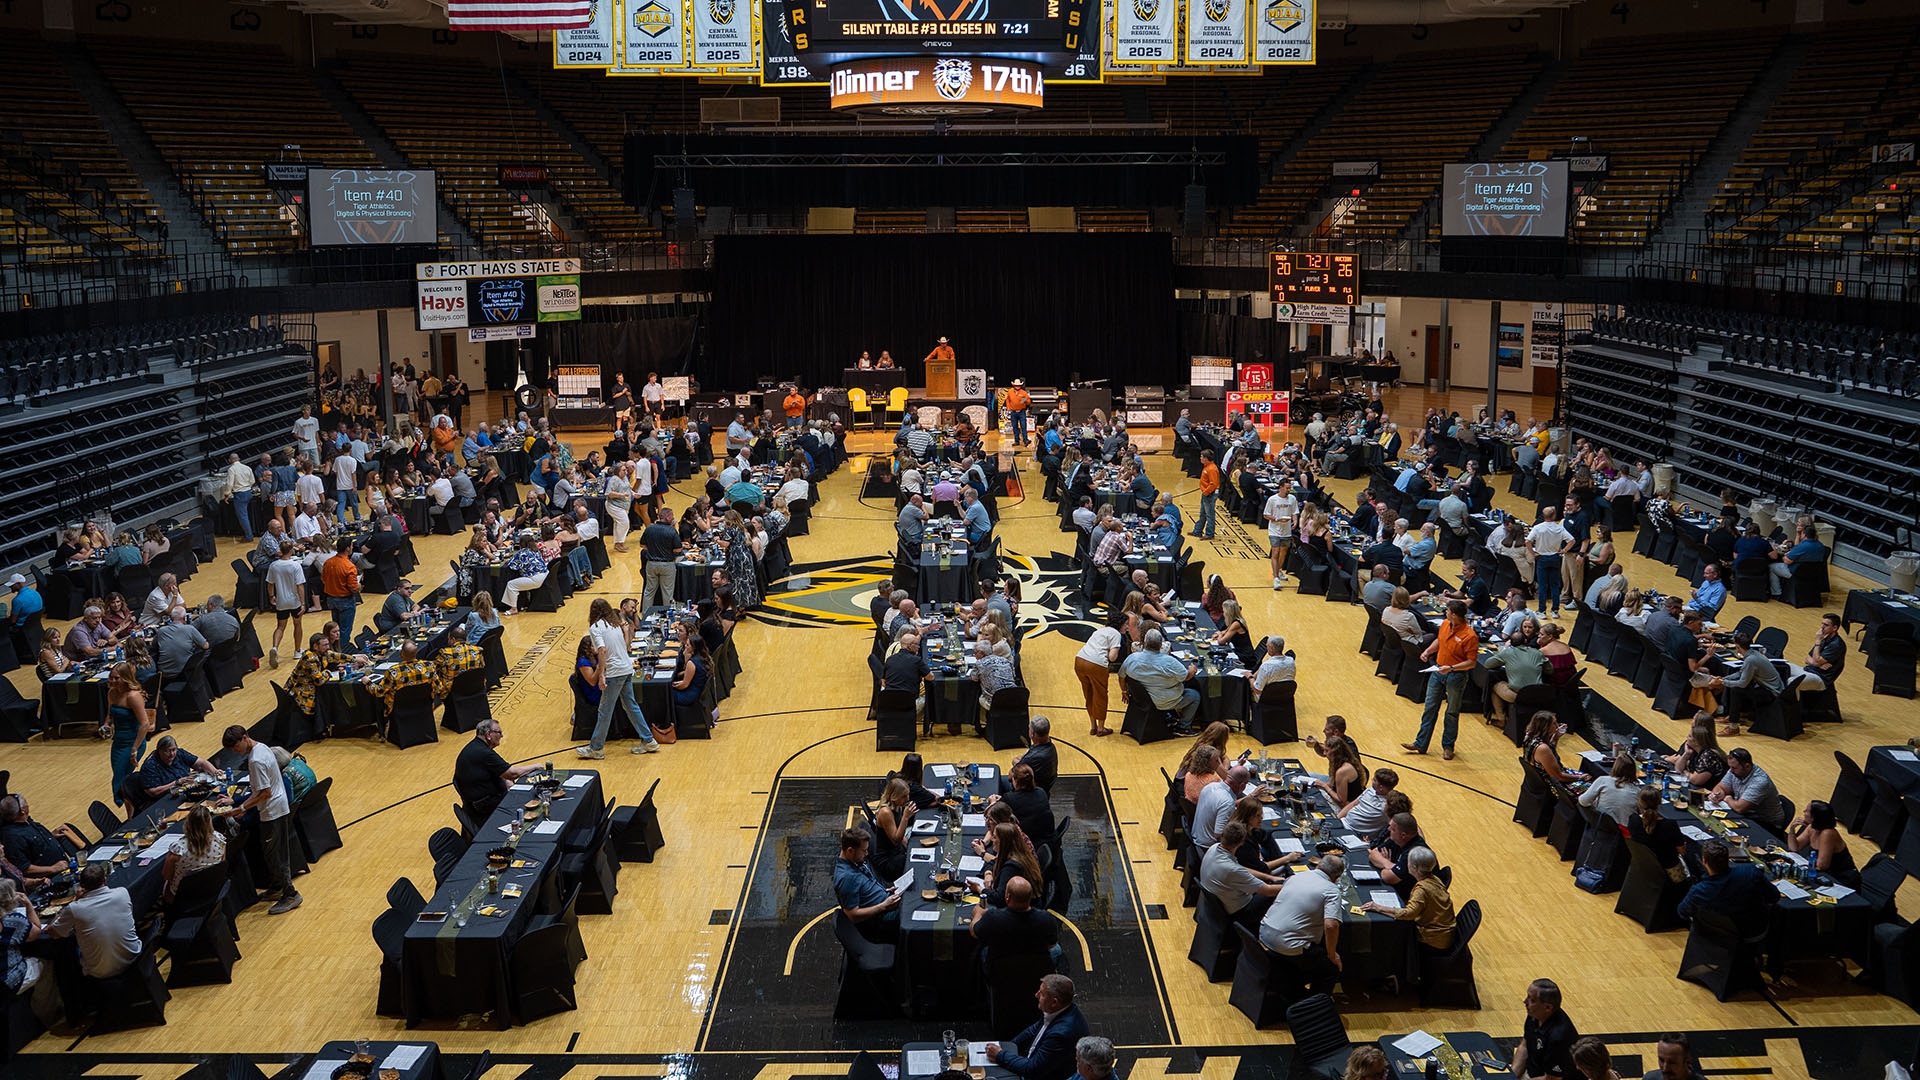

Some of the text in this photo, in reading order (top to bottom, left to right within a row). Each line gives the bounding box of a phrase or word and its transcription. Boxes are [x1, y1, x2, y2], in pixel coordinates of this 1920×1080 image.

[636, 13, 672, 24] MIAA
[1267, 9, 1302, 20] MIAA
[842, 23, 1029, 35] SILENT TABLE #3 CLOSES IN 7:21
[568, 52, 602, 61] 2024
[639, 51, 672, 60] 2025
[707, 50, 740, 60] 2025
[1129, 47, 1162, 56] 2025
[1200, 48, 1234, 58] 2024
[1268, 48, 1301, 58] 2022
[836, 69, 920, 97] Dinner
[981, 65, 1032, 94] 17th
[1474, 182, 1533, 195] Item #40
[344, 190, 403, 201] Item #40
[1305, 255, 1329, 268] 7:21
[440, 261, 560, 276] FORT HAYS STATE
[1277, 262, 1352, 277] 20 26
[1323, 274, 1329, 284] 3
[1279, 292, 1353, 304] 0 0
[422, 296, 465, 312] Hays
[423, 314, 466, 322] VisitHays.com
[1252, 374, 1260, 383] 15
